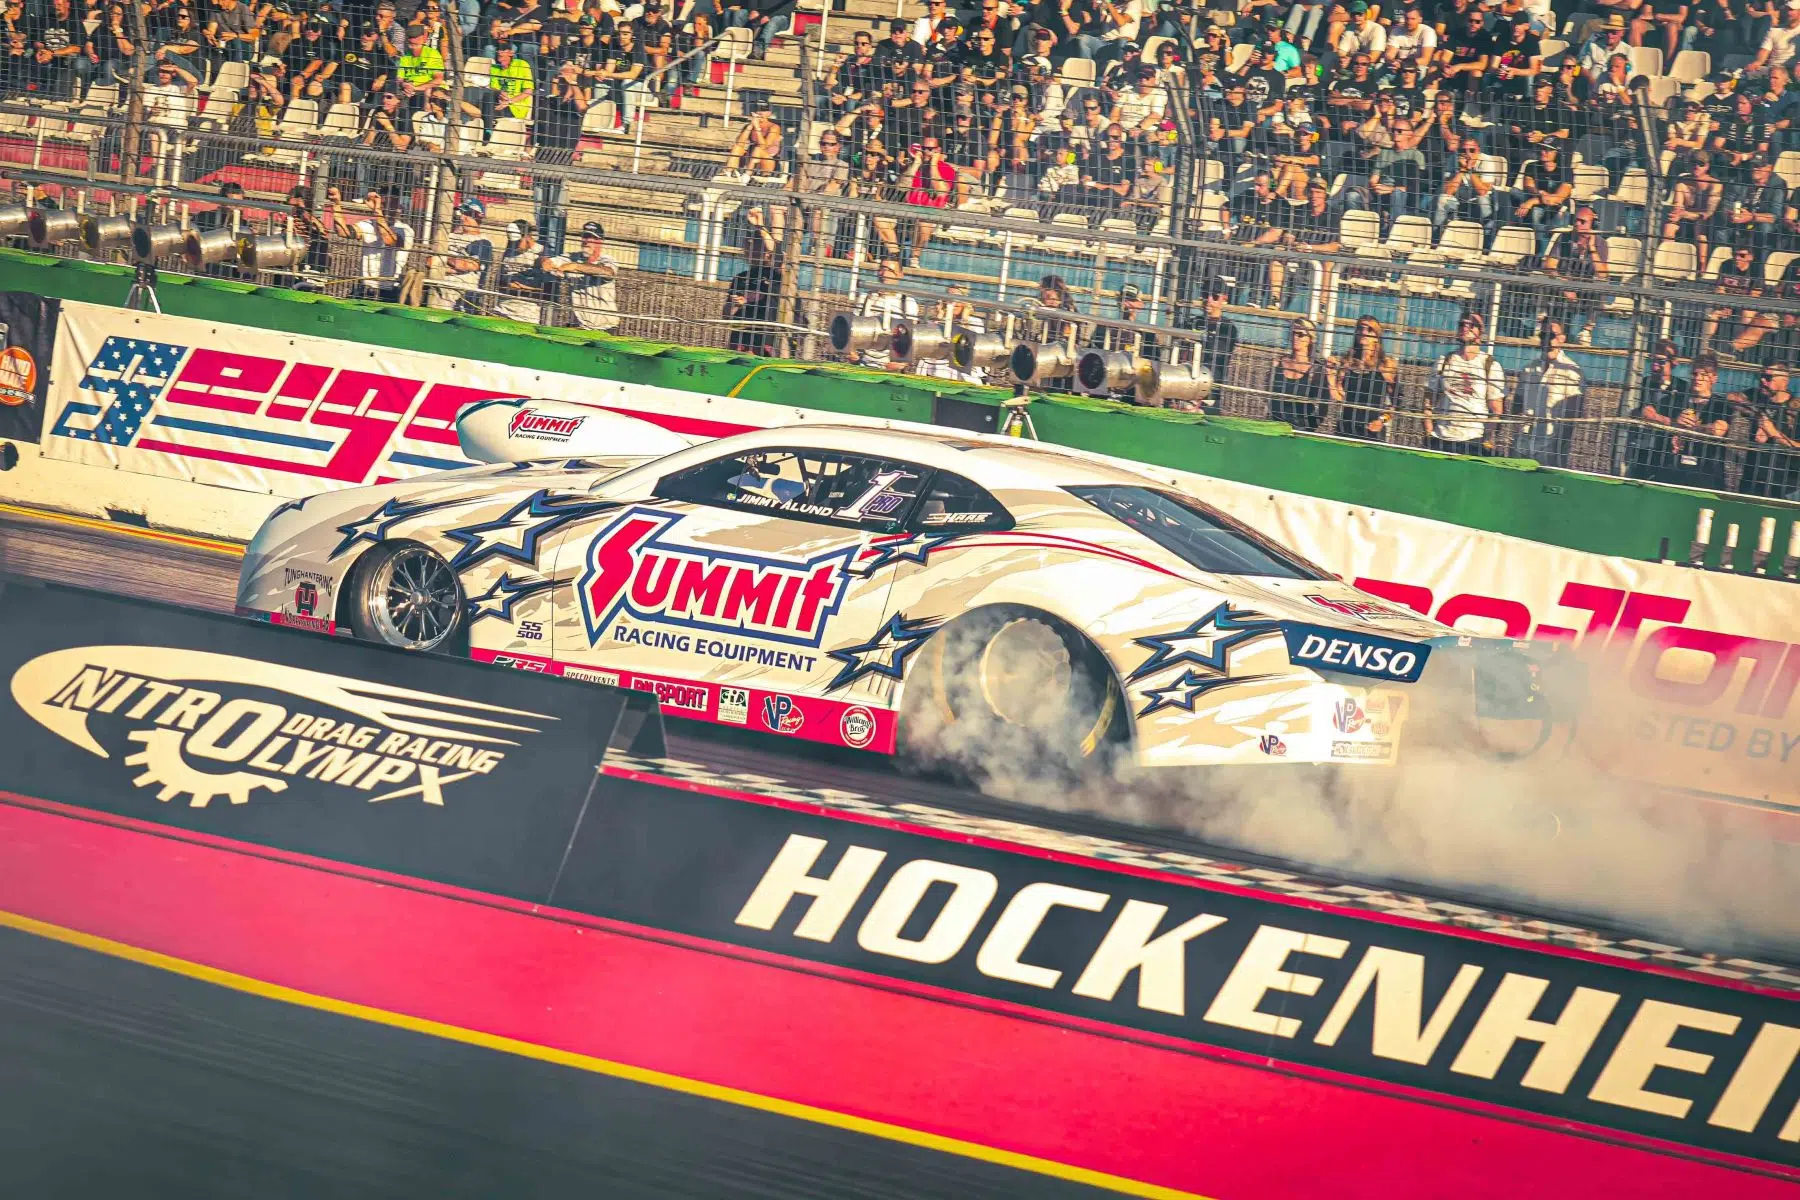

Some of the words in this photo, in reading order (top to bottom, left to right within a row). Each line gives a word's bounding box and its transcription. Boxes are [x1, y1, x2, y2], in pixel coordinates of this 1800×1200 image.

[736, 493, 782, 508] JIMMY
[516, 630, 543, 640] 500
[613, 625, 690, 652] RACING
[694, 638, 817, 673] EQUIPMENT
[1297, 634, 1416, 676] DENSO
[566, 671, 616, 685] SPEEDEVENTS
[656, 683, 706, 709] SPORT
[764, 695, 793, 731] VP
[1335, 697, 1357, 733] VP
[279, 712, 382, 749] DRAG
[376, 732, 505, 775] RACING
[1260, 734, 1279, 755] VP
[734, 833, 1800, 1144] HOCKENHEI
